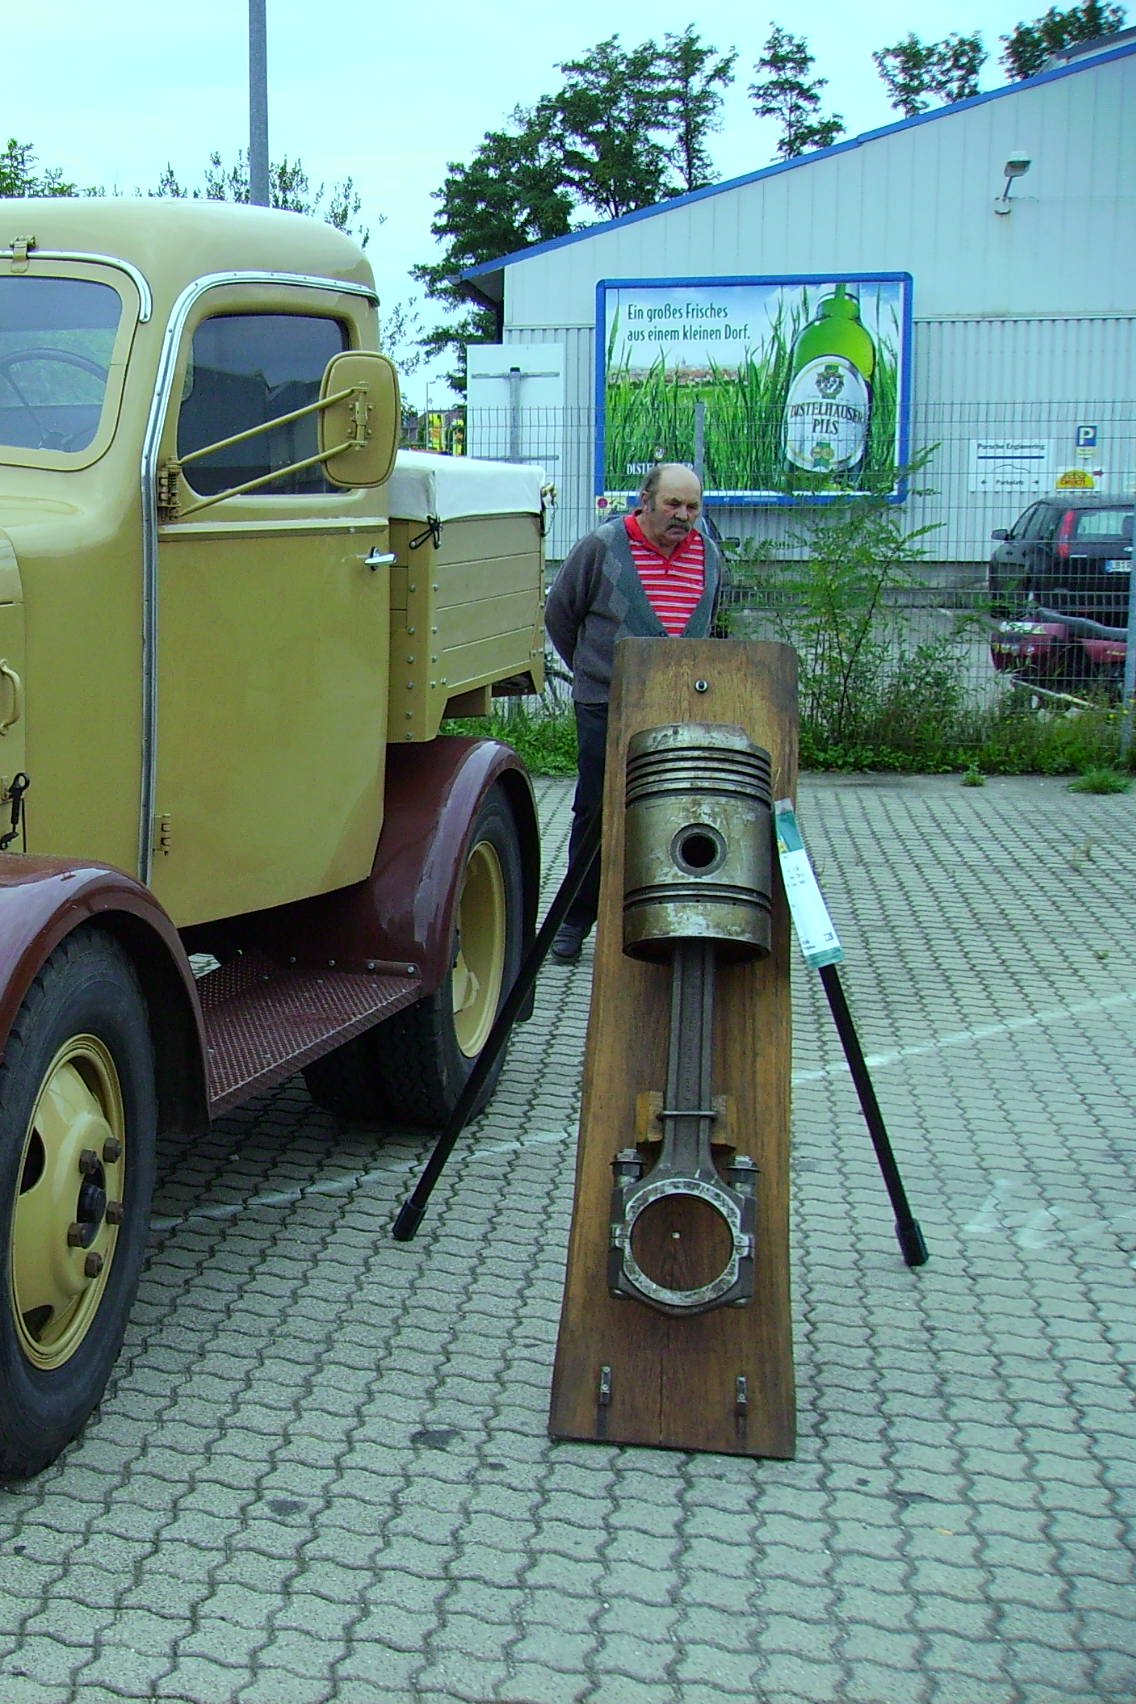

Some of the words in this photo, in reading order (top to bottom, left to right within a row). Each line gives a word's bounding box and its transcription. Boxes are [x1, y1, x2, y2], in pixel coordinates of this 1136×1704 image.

[627, 303, 644, 320] Ein
[646, 303, 683, 323] großes
[685, 302, 728, 319] Frisches
[627, 329, 645, 341] aus
[648, 326, 679, 341] einem
[682, 324, 721, 341] kleinen
[723, 323, 750, 340] Dorf.
[812, 419, 839, 435] PILS
[1079, 427, 1094, 445] P
